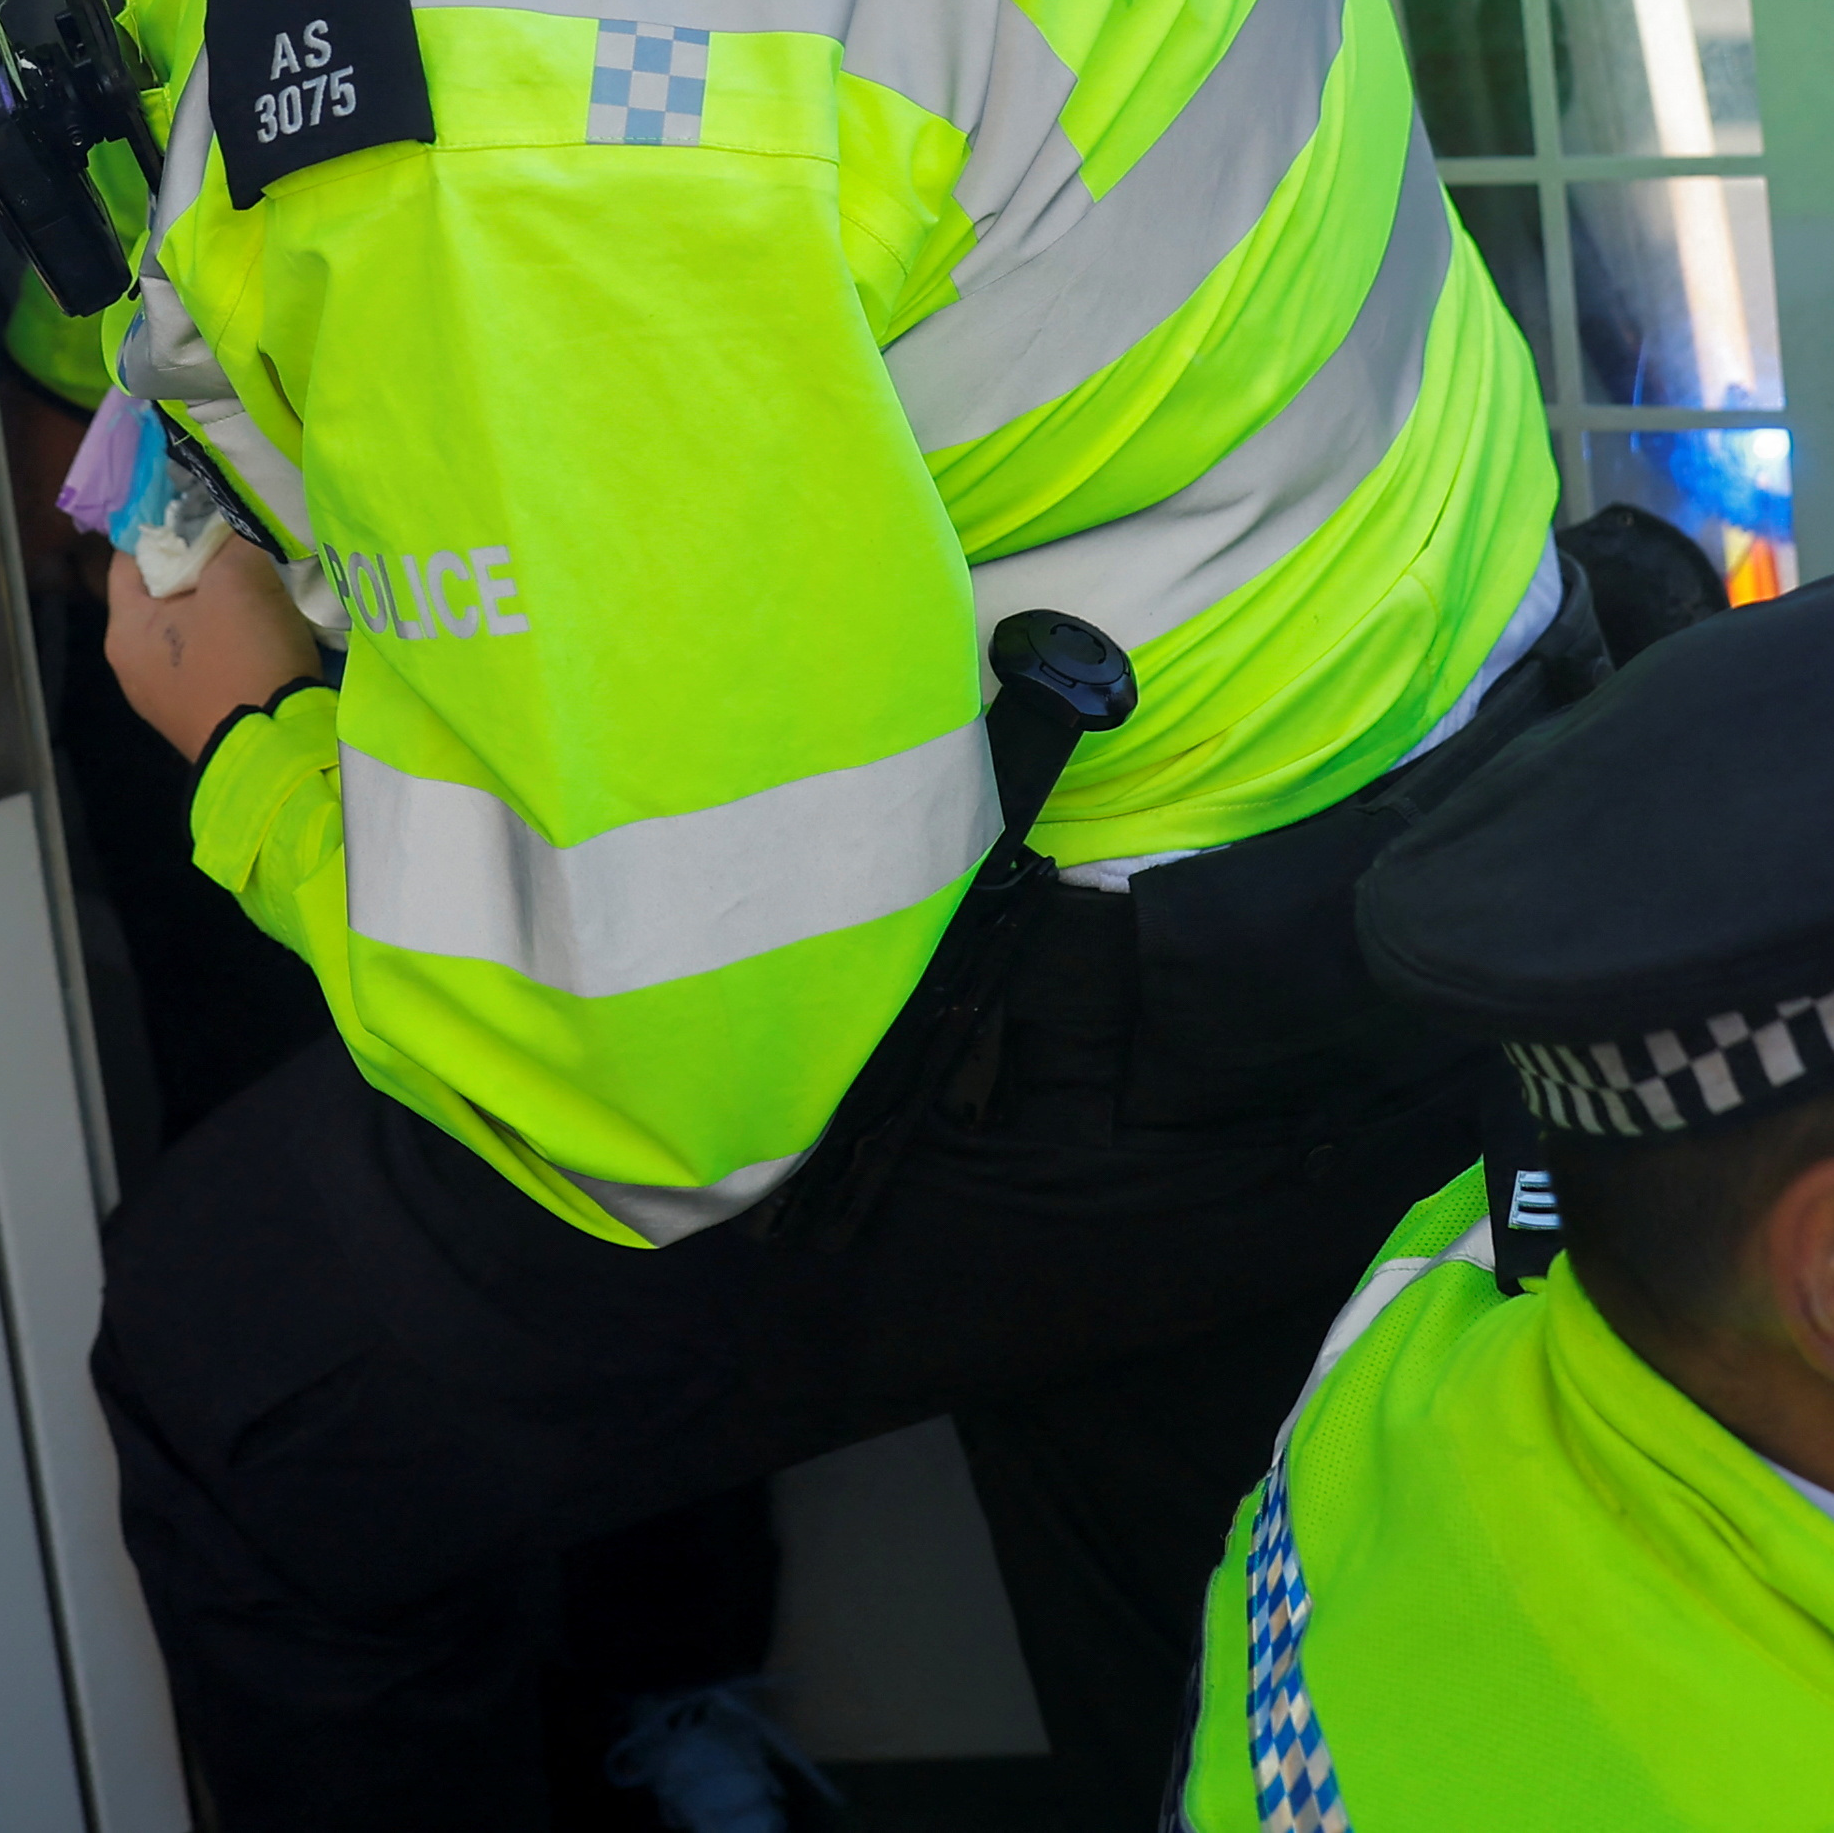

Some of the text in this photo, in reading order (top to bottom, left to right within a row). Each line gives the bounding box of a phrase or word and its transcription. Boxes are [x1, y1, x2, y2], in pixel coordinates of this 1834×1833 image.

[269, 19, 332, 81] AS
[254, 66, 357, 143] 3075
[323, 542, 530, 640] POLICE
